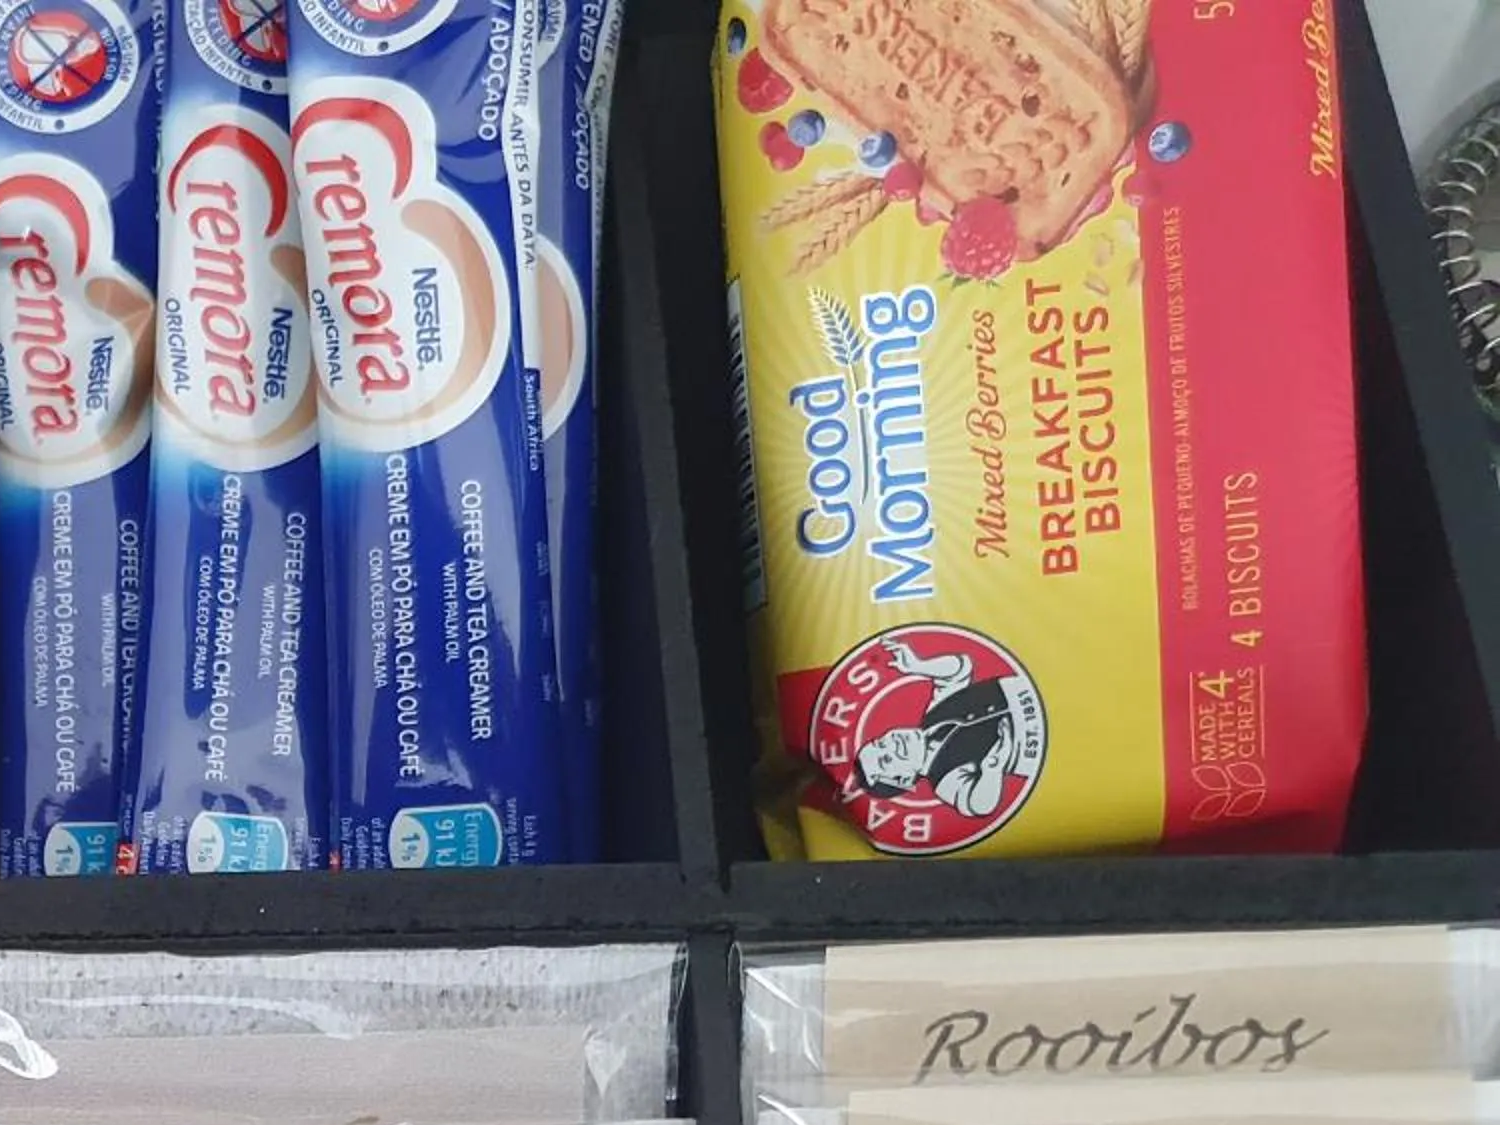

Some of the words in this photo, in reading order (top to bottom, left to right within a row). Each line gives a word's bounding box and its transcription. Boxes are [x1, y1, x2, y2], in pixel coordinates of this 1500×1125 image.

[478, 17, 507, 141] ADOÇADO
[510, 113, 529, 174] ANTES
[1309, 58, 1337, 179] Mixed
[518, 178, 533, 207] DA
[167, 124, 288, 418] Cremora
[291, 97, 413, 395] Cremora
[1163, 206, 1185, 291] SILVESTRES
[164, 297, 191, 396] ORIGINAL
[311, 287, 345, 389] ORIGINAL
[1168, 294, 1187, 351] FRUTOS
[965, 308, 1008, 443] Berries
[1171, 357, 1186, 377] DE
[853, 285, 936, 603] Morning
[1025, 277, 1079, 576] BREAKFAST
[1073, 305, 1122, 535] BISCUITS
[386, 452, 410, 526] CREME
[790, 374, 856, 558] Good
[53, 490, 73, 557] CREME
[221, 472, 243, 541] CREME
[461, 479, 484, 555] COFFEE
[966, 445, 1011, 560] Mixed
[1180, 513, 1195, 534] DE
[120, 518, 139, 588] COFFEE
[219, 544, 239, 578] EM
[284, 511, 306, 583] COFFEE
[389, 528, 411, 561] EM
[1223, 470, 1263, 618] BISCUITS
[54, 558, 74, 592] EM
[391, 561, 418, 593] PÓ
[443, 561, 457, 598] WITH
[464, 556, 487, 602] AND
[122, 590, 140, 630] AND
[263, 584, 276, 618] WITH
[281, 583, 303, 625] AND
[394, 595, 416, 650] PARA
[444, 599, 459, 640] PALM
[467, 603, 488, 644] TEA
[55, 622, 75, 674] PARA
[214, 606, 235, 658] PARA
[279, 626, 301, 664] TEA
[1231, 629, 1263, 648] 4
[55, 674, 78, 713] CHÁ
[211, 659, 236, 700] CHÁ
[396, 651, 423, 693] CHÁ
[468, 645, 494, 742] CREAMER
[55, 714, 75, 746] OU
[209, 700, 229, 732] OU
[271, 665, 297, 757] CREAMER
[397, 693, 419, 728] OU
[1016, 688, 1037, 722] 1851
[1236, 665, 1256, 761] CEREALS
[398, 729, 425, 779] CAFÉ
[1023, 725, 1039, 761] EST.
[1199, 702, 1218, 763] MADE
[1218, 700, 1237, 762] WITH
[55, 746, 78, 794] CAFÉ
[205, 733, 229, 784] CAFÉ
[229, 826, 249, 849] 91
[401, 831, 421, 863] 1%
[435, 818, 455, 842] 91
[436, 848, 456, 867] kJ
[912, 993, 1331, 1086] Rooibos
